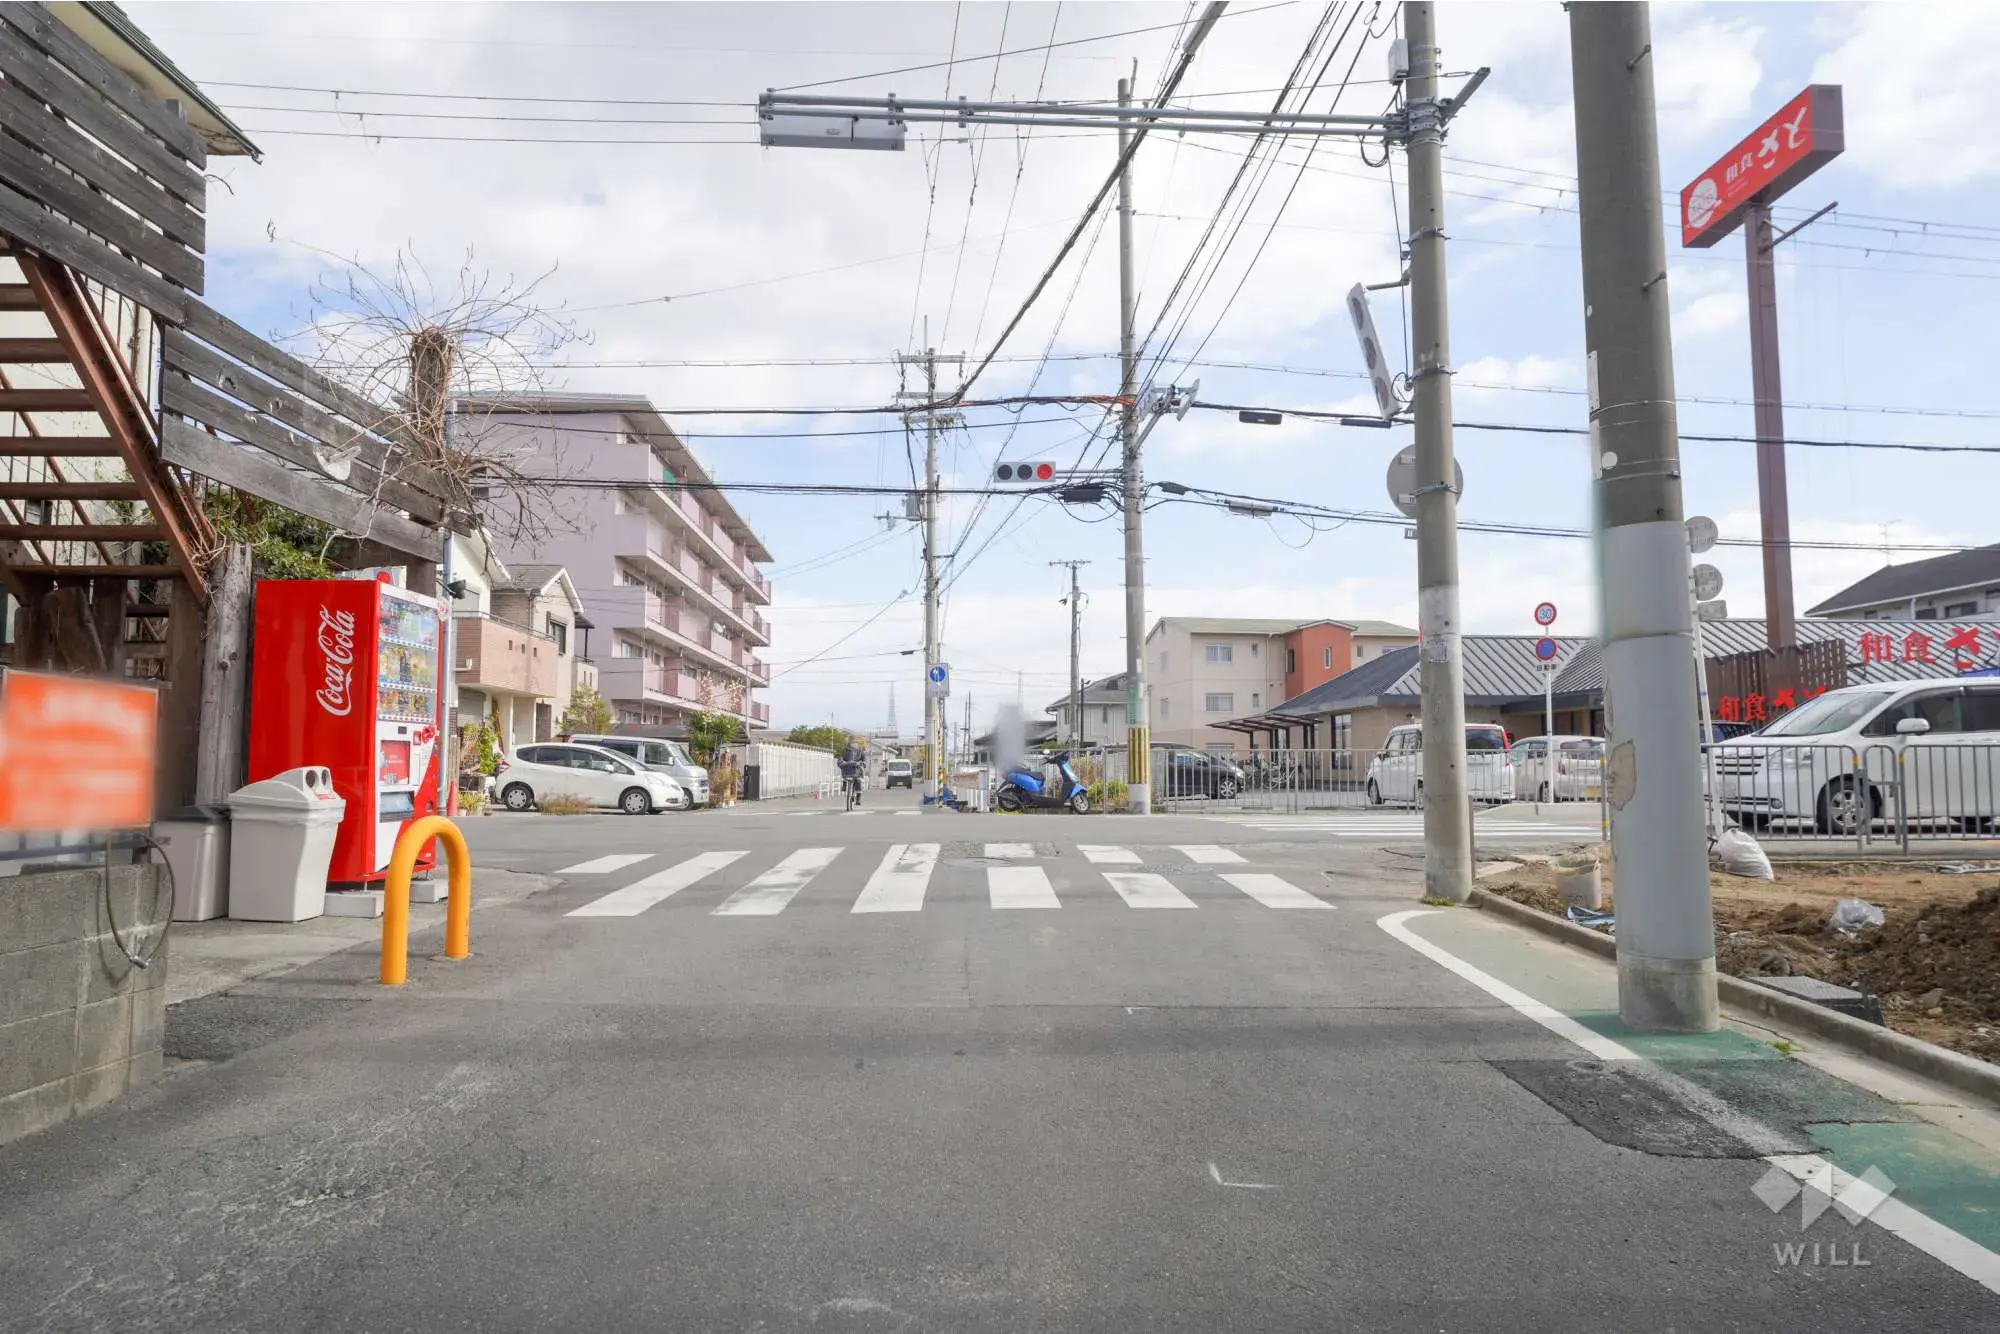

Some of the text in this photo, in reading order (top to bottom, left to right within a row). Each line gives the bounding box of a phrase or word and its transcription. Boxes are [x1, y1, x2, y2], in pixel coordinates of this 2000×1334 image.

[316, 604, 355, 716] Coca-Cola
[1860, 626, 2000, 670] 和食さ
